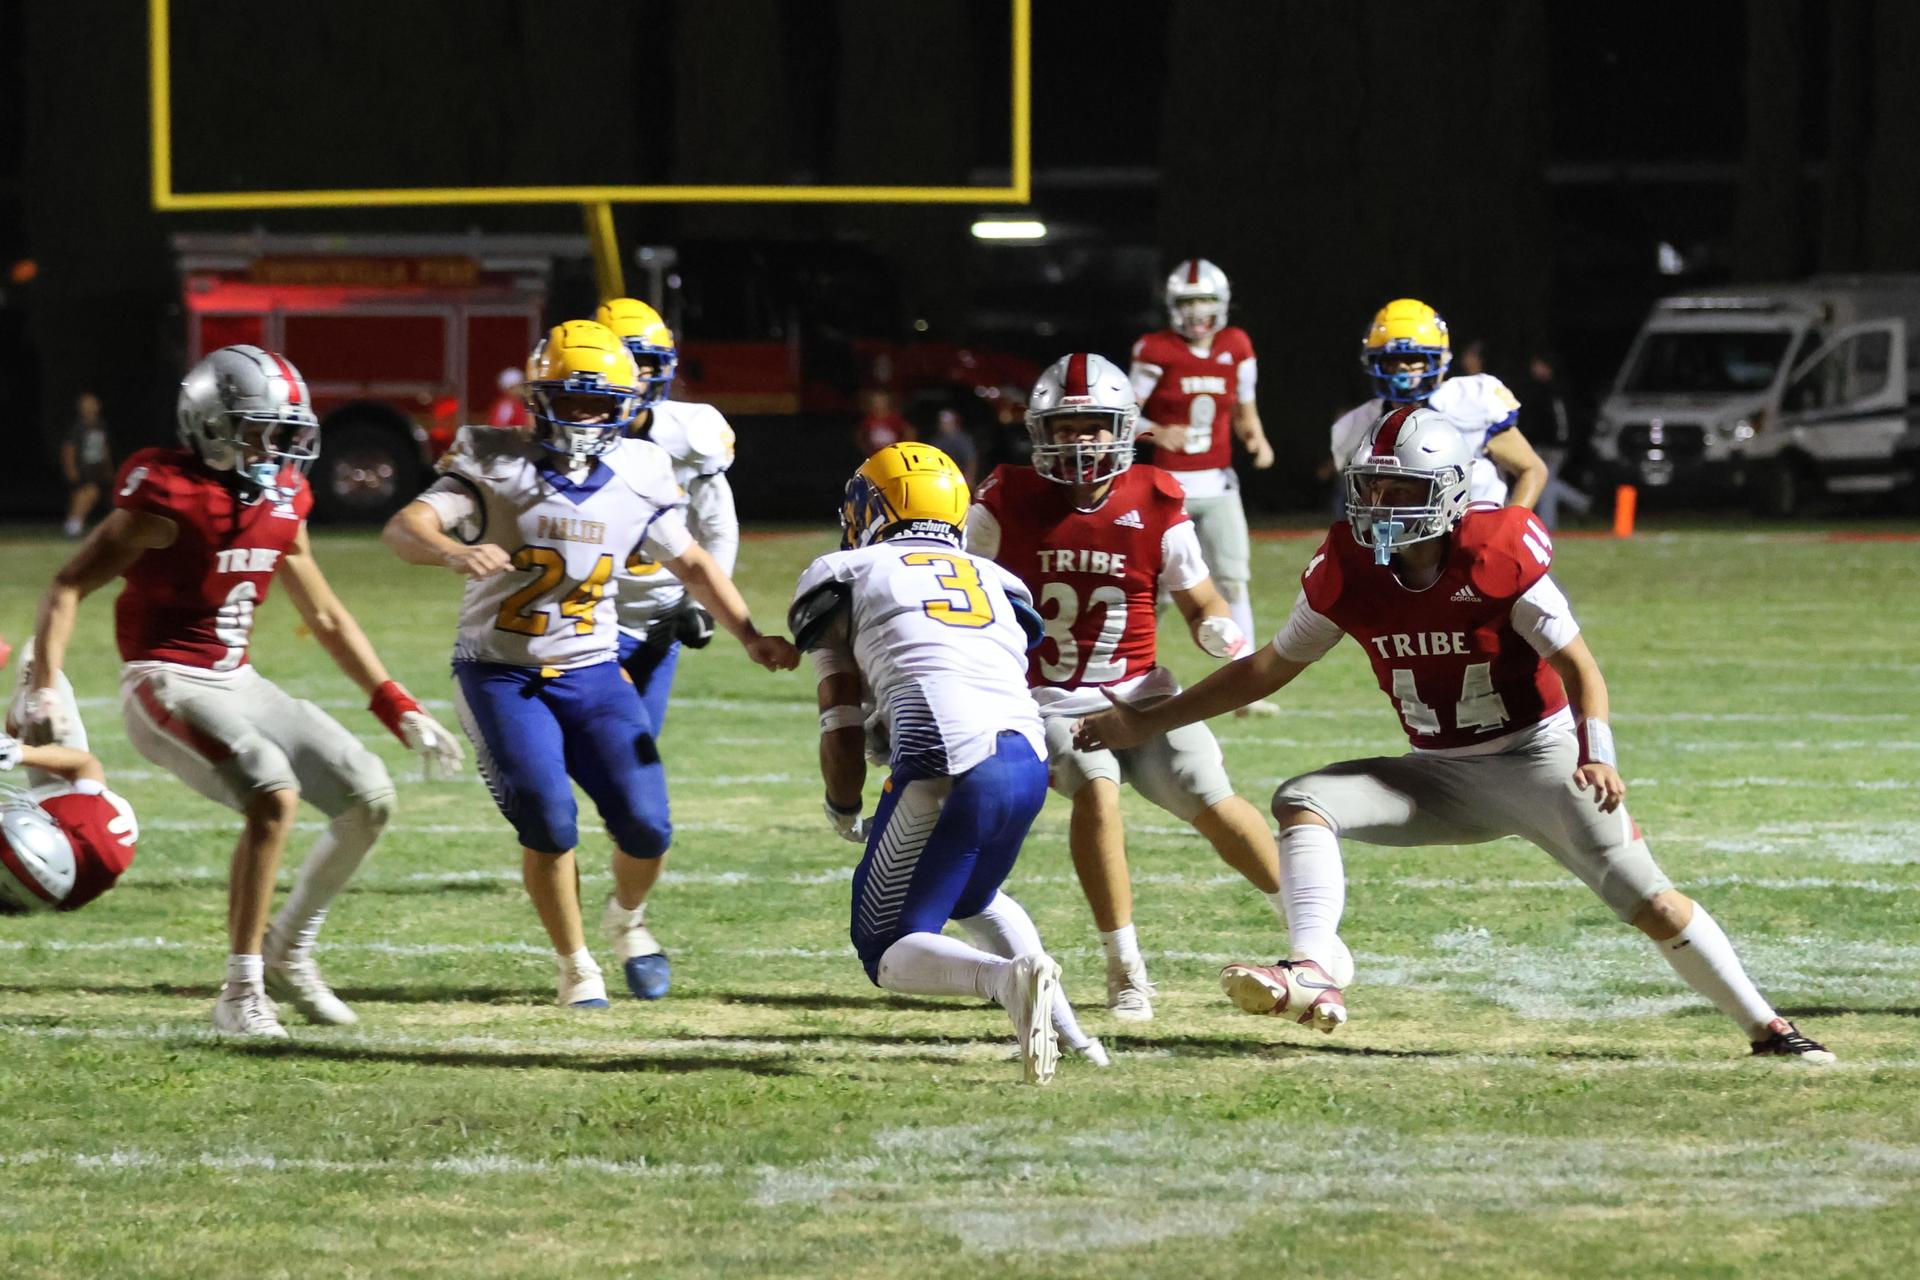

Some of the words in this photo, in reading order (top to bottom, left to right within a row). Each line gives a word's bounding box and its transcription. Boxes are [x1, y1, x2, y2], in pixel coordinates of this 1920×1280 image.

[216, 547, 283, 574] TRIBE
[1037, 549, 1128, 578] TRIBE
[494, 544, 614, 637] 24
[900, 552, 996, 630] 3
[1450, 595, 1483, 603] adidas
[1039, 582, 1128, 683] 32
[1372, 631, 1471, 659] TRIBE
[1392, 661, 1511, 737] 44
